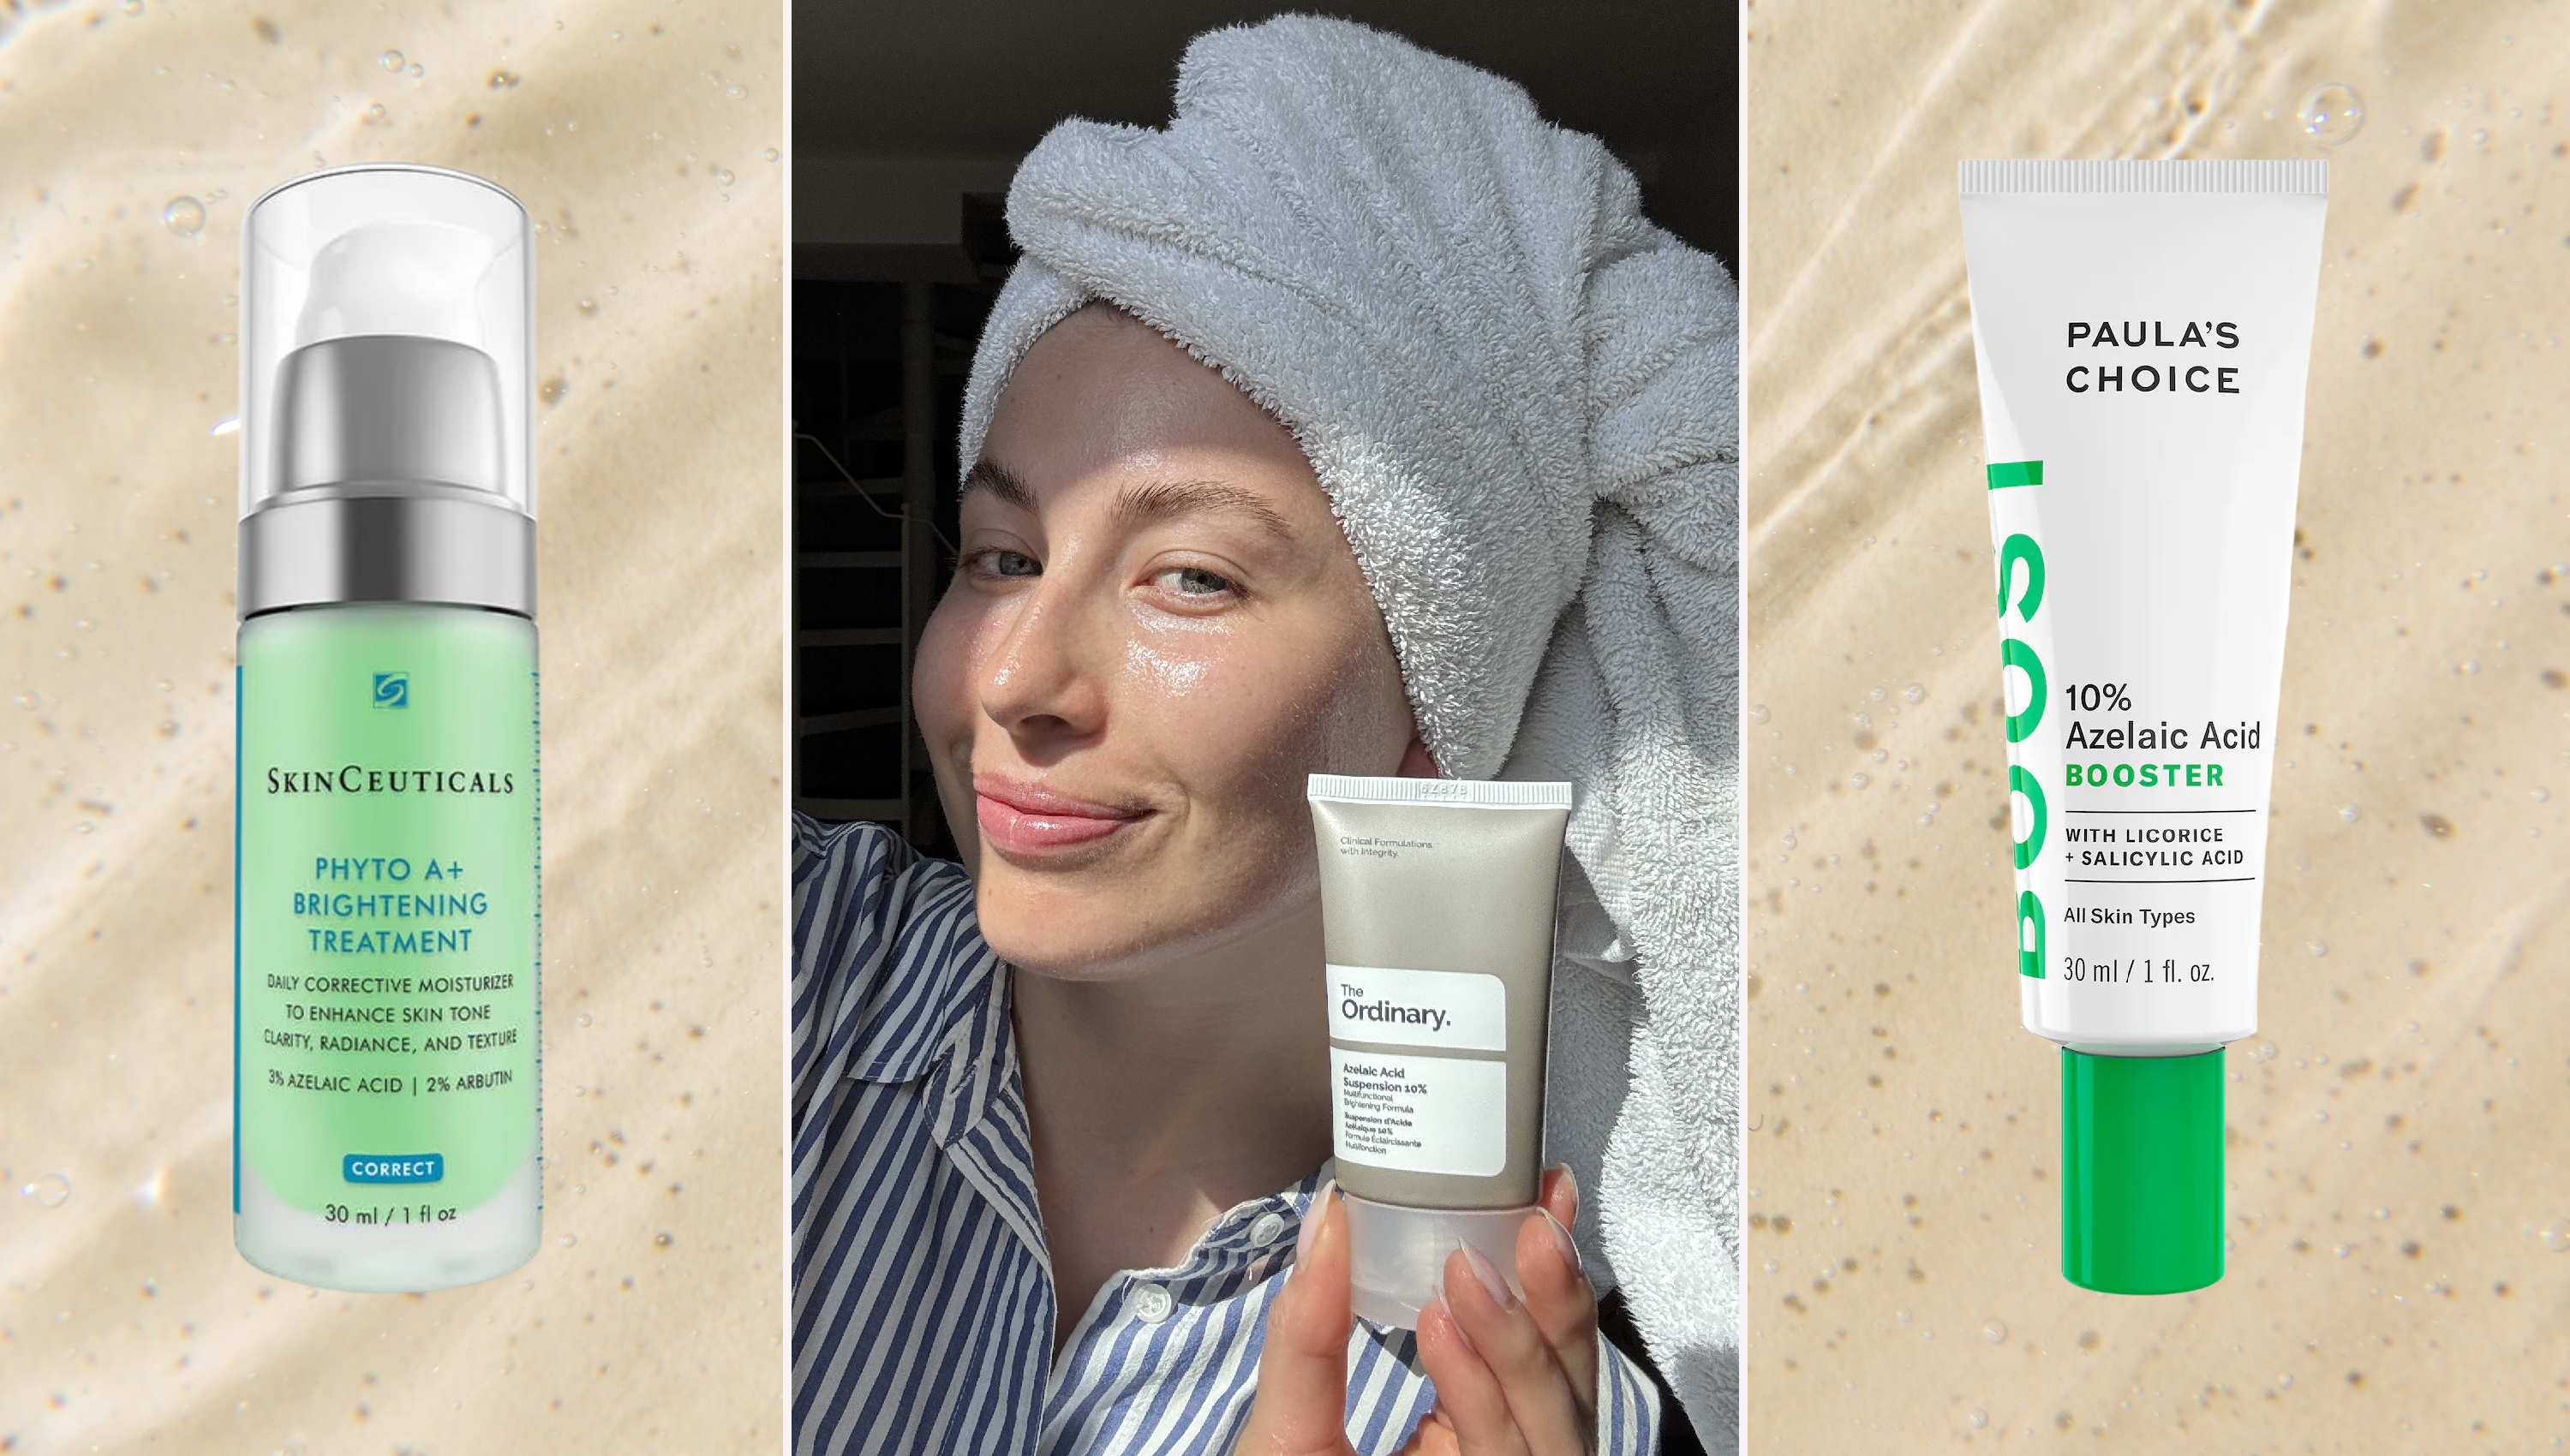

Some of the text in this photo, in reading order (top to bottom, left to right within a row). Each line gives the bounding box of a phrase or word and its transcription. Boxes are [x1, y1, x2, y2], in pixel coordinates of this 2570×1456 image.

[2066, 365, 2240, 394] CHOICE
[2065, 683, 2132, 712] 10%
[2065, 720, 2261, 749] Azelaic Acid
[2065, 763, 2223, 788] BOOSTER
[1341, 837, 1432, 848] Clinical Formulations
[2065, 827, 2224, 844] WITH LICORICE
[316, 857, 463, 880] PHYTO A+
[2065, 849, 2244, 867] + SALICYLIC ACID
[294, 892, 488, 917] BRIGHTENING
[2064, 907, 2196, 928] All Skin Types
[308, 928, 473, 953] TREATMENT
[2064, 957, 2086, 982] 30
[2093, 959, 2118, 982] ml
[2144, 959, 2154, 982] 1
[2163, 960, 2182, 983] fl.
[2190, 964, 2214, 982] oz.
[267, 974, 514, 994] DAILY CORRECTIVE MOISTURIZER
[1341, 984, 1364, 997] The
[286, 1005, 491, 1023] TO ENHANCE SKIN TONE
[1342, 999, 1451, 1031] Ordinary.
[265, 1029, 517, 1053] CLARITY, RADIANCE, AND TEXTURE
[1343, 1063, 1405, 1078] Azelaic Acid
[269, 1070, 284, 1086] 3%
[288, 1072, 350, 1092] AZELAIC
[357, 1077, 403, 1093] ACID
[427, 1076, 451, 1092] 2%
[456, 1071, 512, 1089] ARBUTIN
[1343, 1077, 1427, 1095] Suspension 10%
[1345, 1112, 1382, 1125] Suspension
[1382, 1103, 1414, 1113] Formula
[1346, 1131, 1370, 1143] Formule
[352, 1161, 435, 1177] CORRECT
[325, 1203, 349, 1223] 30
[356, 1205, 378, 1225] ml
[403, 1207, 409, 1224] 1
[420, 1204, 430, 1223] fl
[438, 1206, 457, 1221] oz
